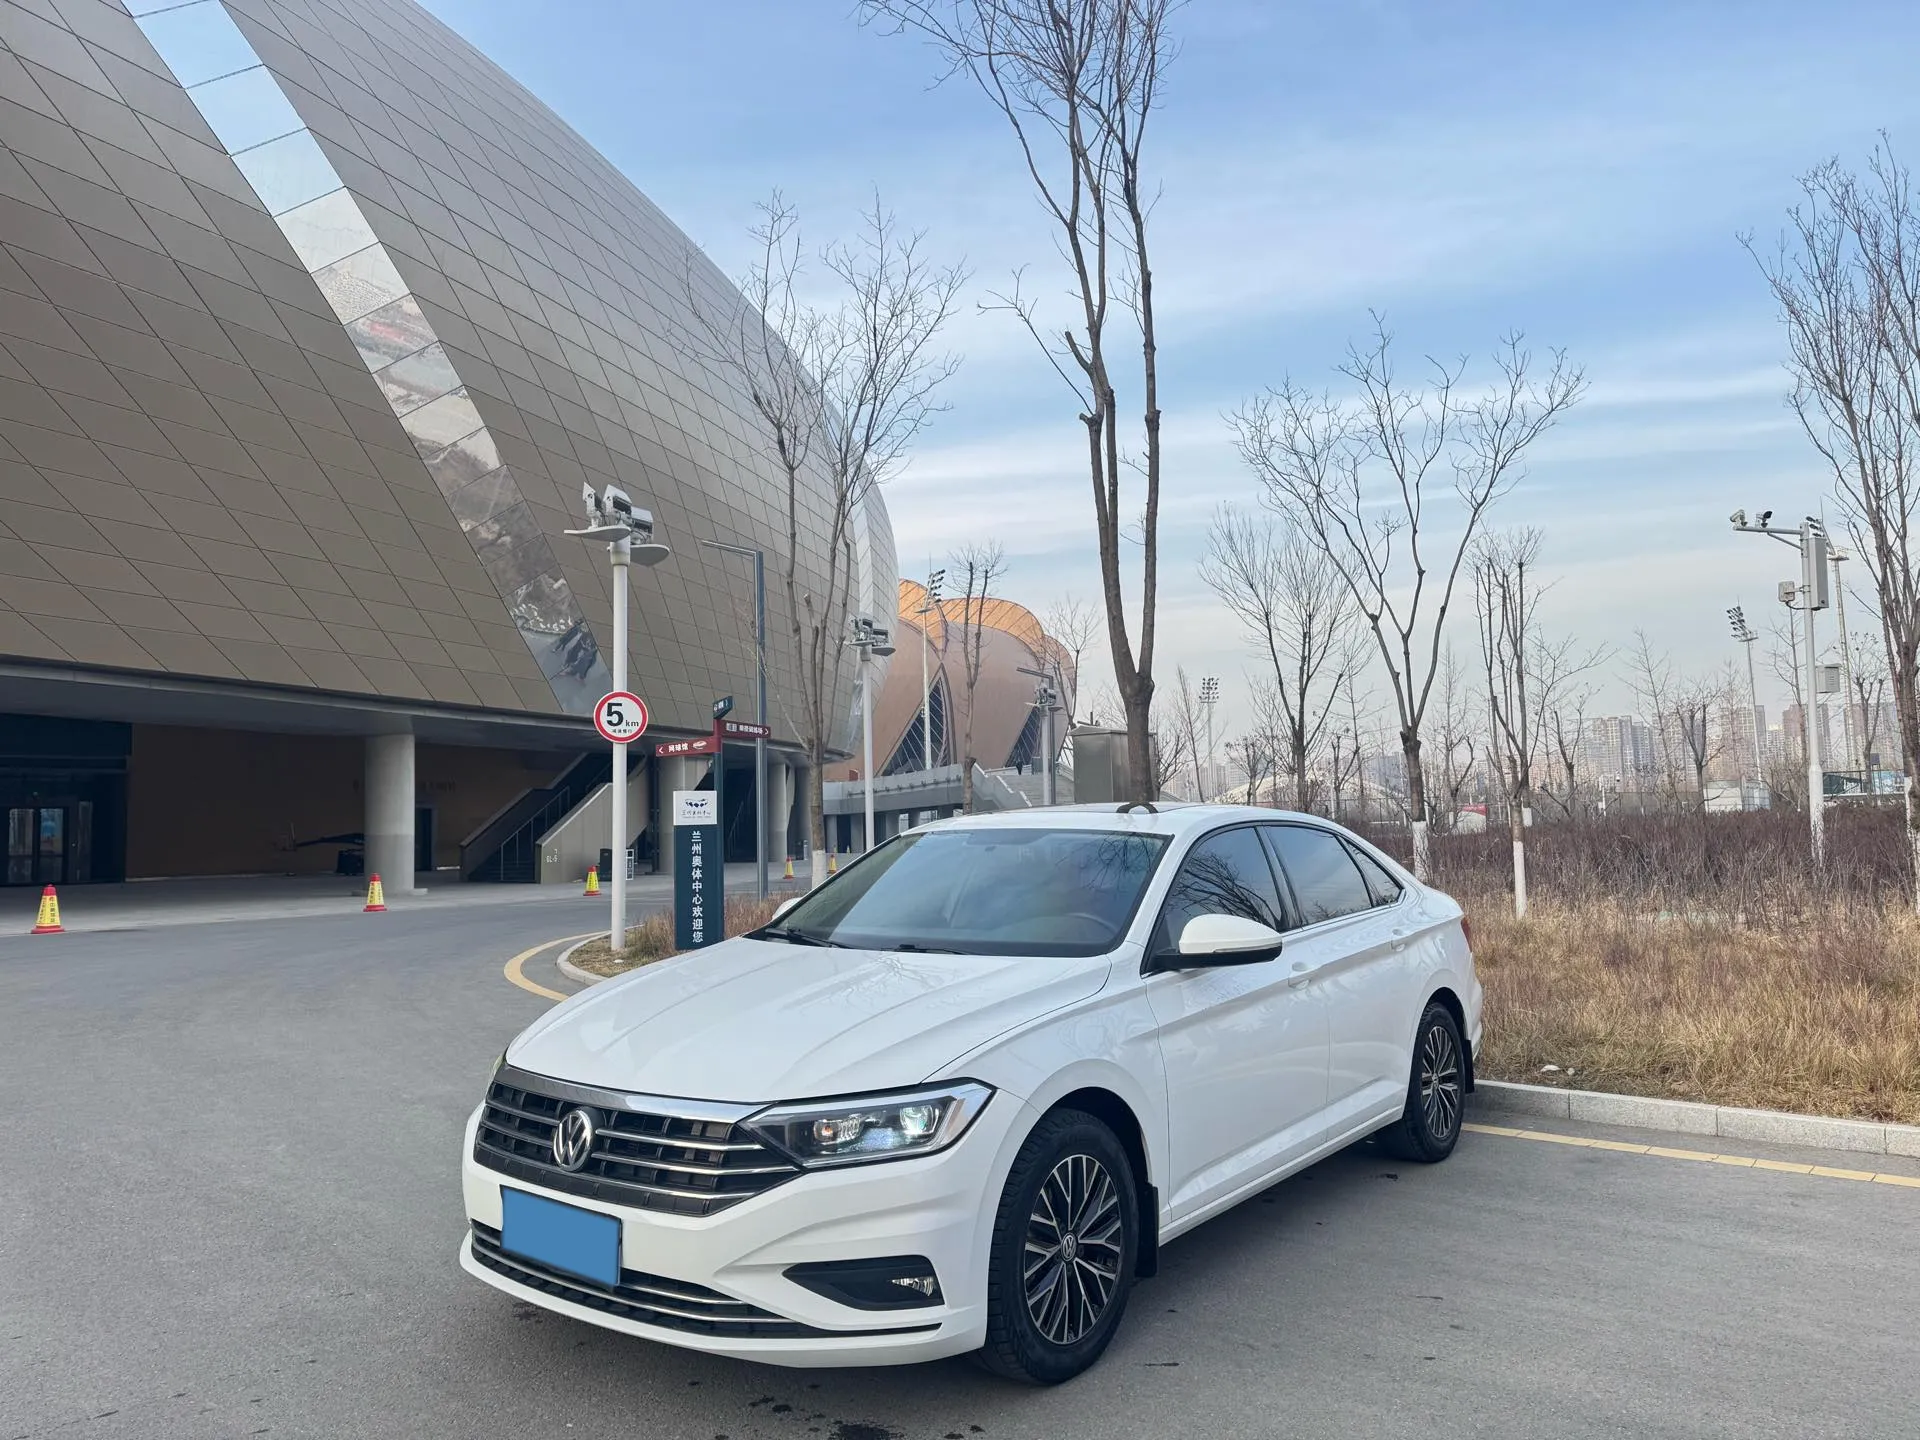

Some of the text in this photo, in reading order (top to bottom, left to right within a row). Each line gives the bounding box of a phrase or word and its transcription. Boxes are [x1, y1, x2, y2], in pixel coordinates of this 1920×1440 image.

[606, 702, 639, 727] 5 km
[668, 742, 689, 753] 网球馆
[691, 830, 704, 943] 兰州奥体中心欢迎您
